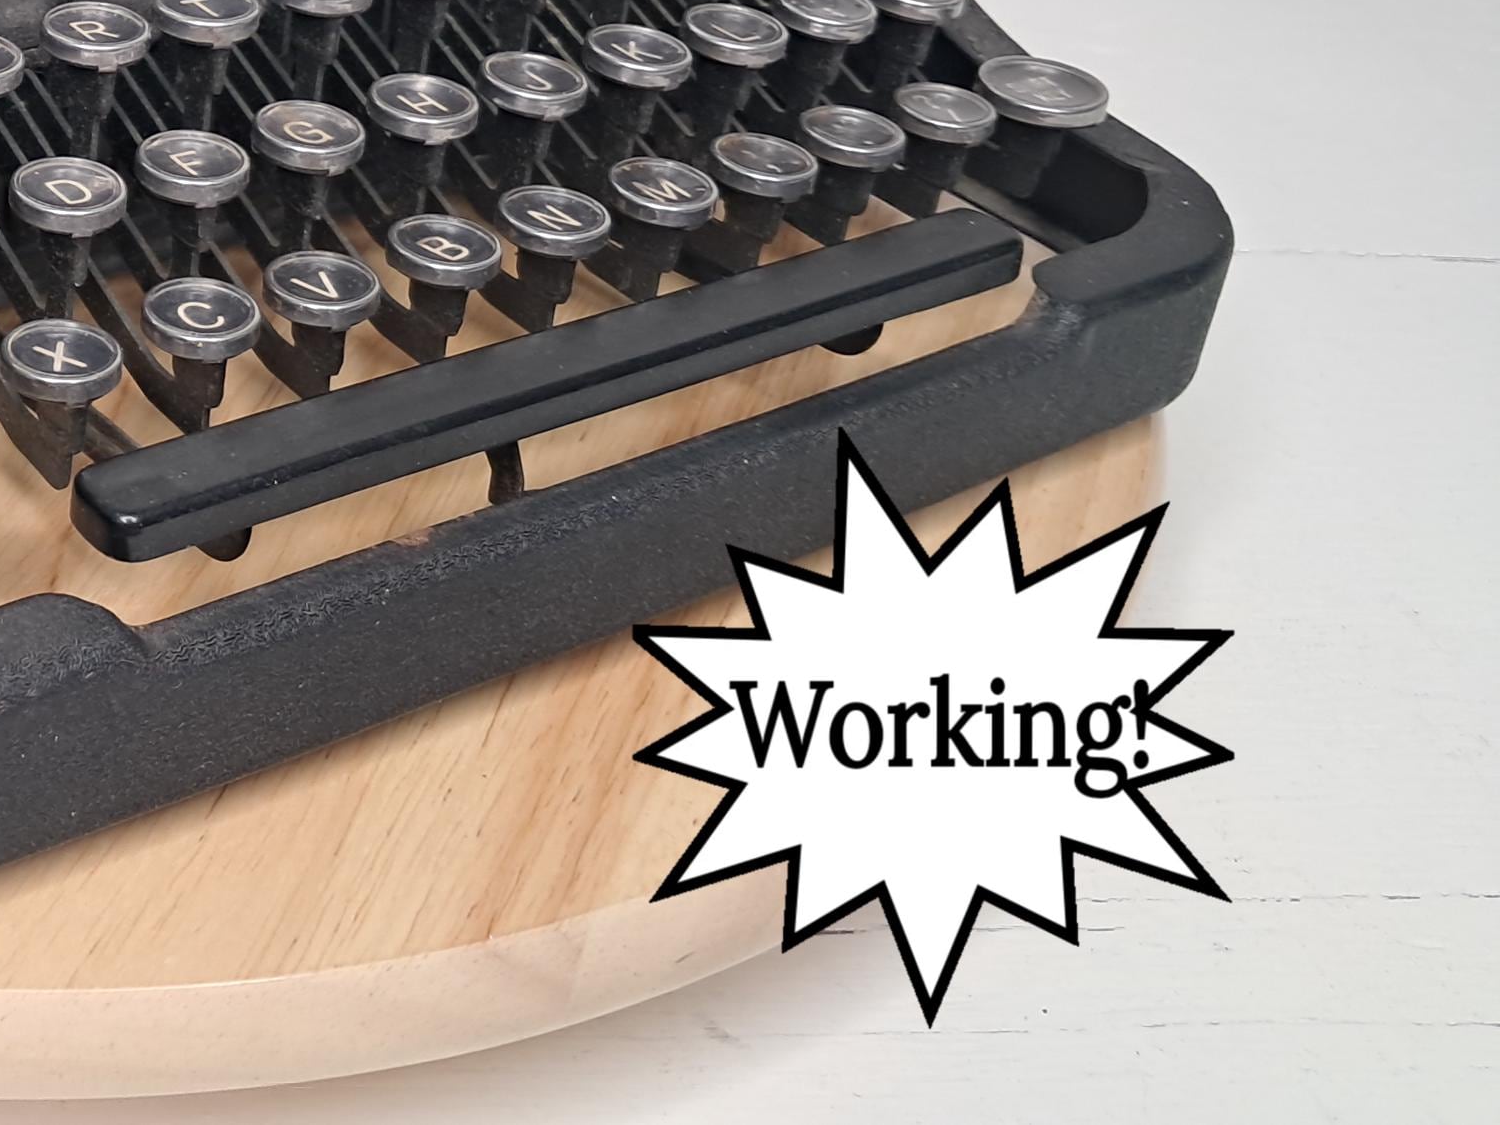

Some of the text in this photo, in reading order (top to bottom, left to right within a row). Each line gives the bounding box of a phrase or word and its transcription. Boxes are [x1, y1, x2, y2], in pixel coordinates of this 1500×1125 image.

[68, 20, 119, 43] R
[710, 22, 760, 42] L
[611, 40, 664, 61] K
[397, 91, 448, 115] H
[283, 120, 334, 145] G
[168, 150, 203, 175] F
[44, 179, 92, 205] D
[630, 177, 692, 203] M
[526, 204, 582, 230] N
[416, 235, 470, 262] B
[290, 270, 340, 299] V
[176, 300, 225, 329] C
[32, 340, 88, 372] X
